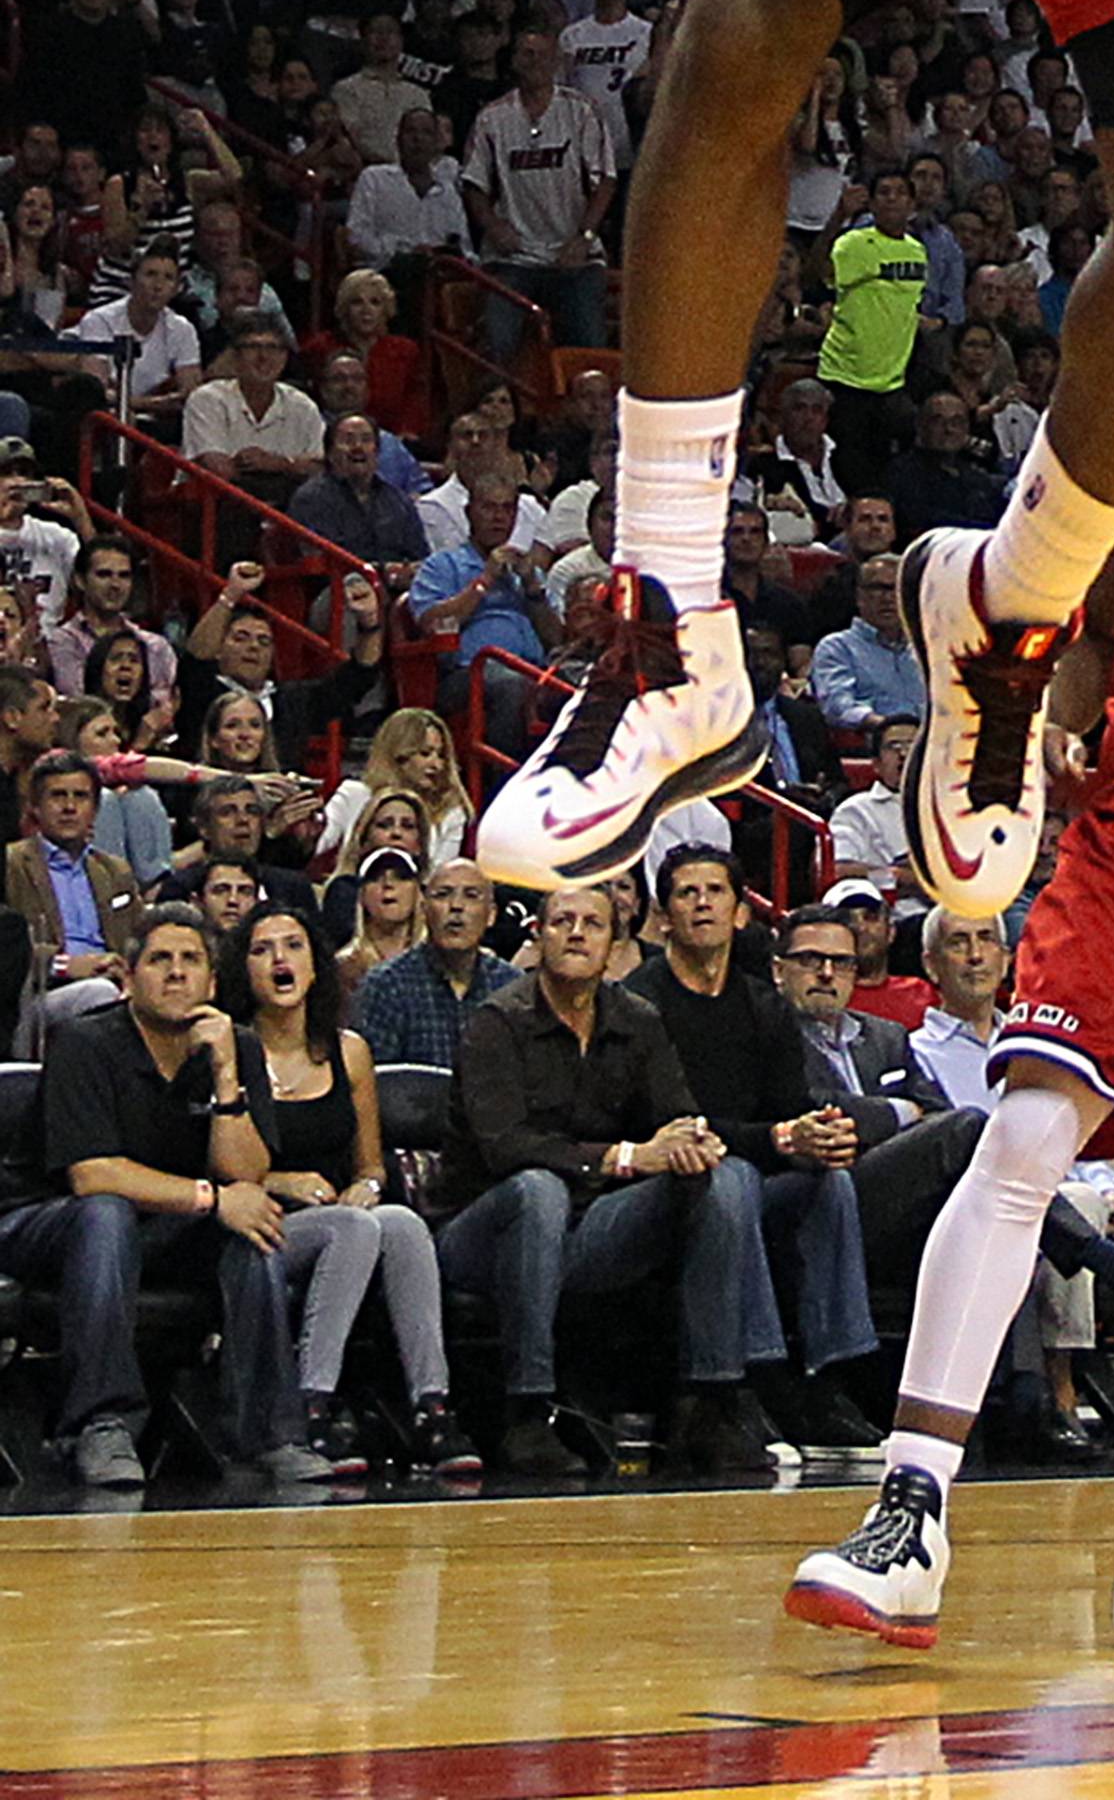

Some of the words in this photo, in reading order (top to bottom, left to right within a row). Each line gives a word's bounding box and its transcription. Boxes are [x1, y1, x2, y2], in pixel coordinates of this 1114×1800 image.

[574, 41, 636, 65] HEAT
[607, 68, 625, 91] 3
[1006, 1002, 1080, 1033] AMI
